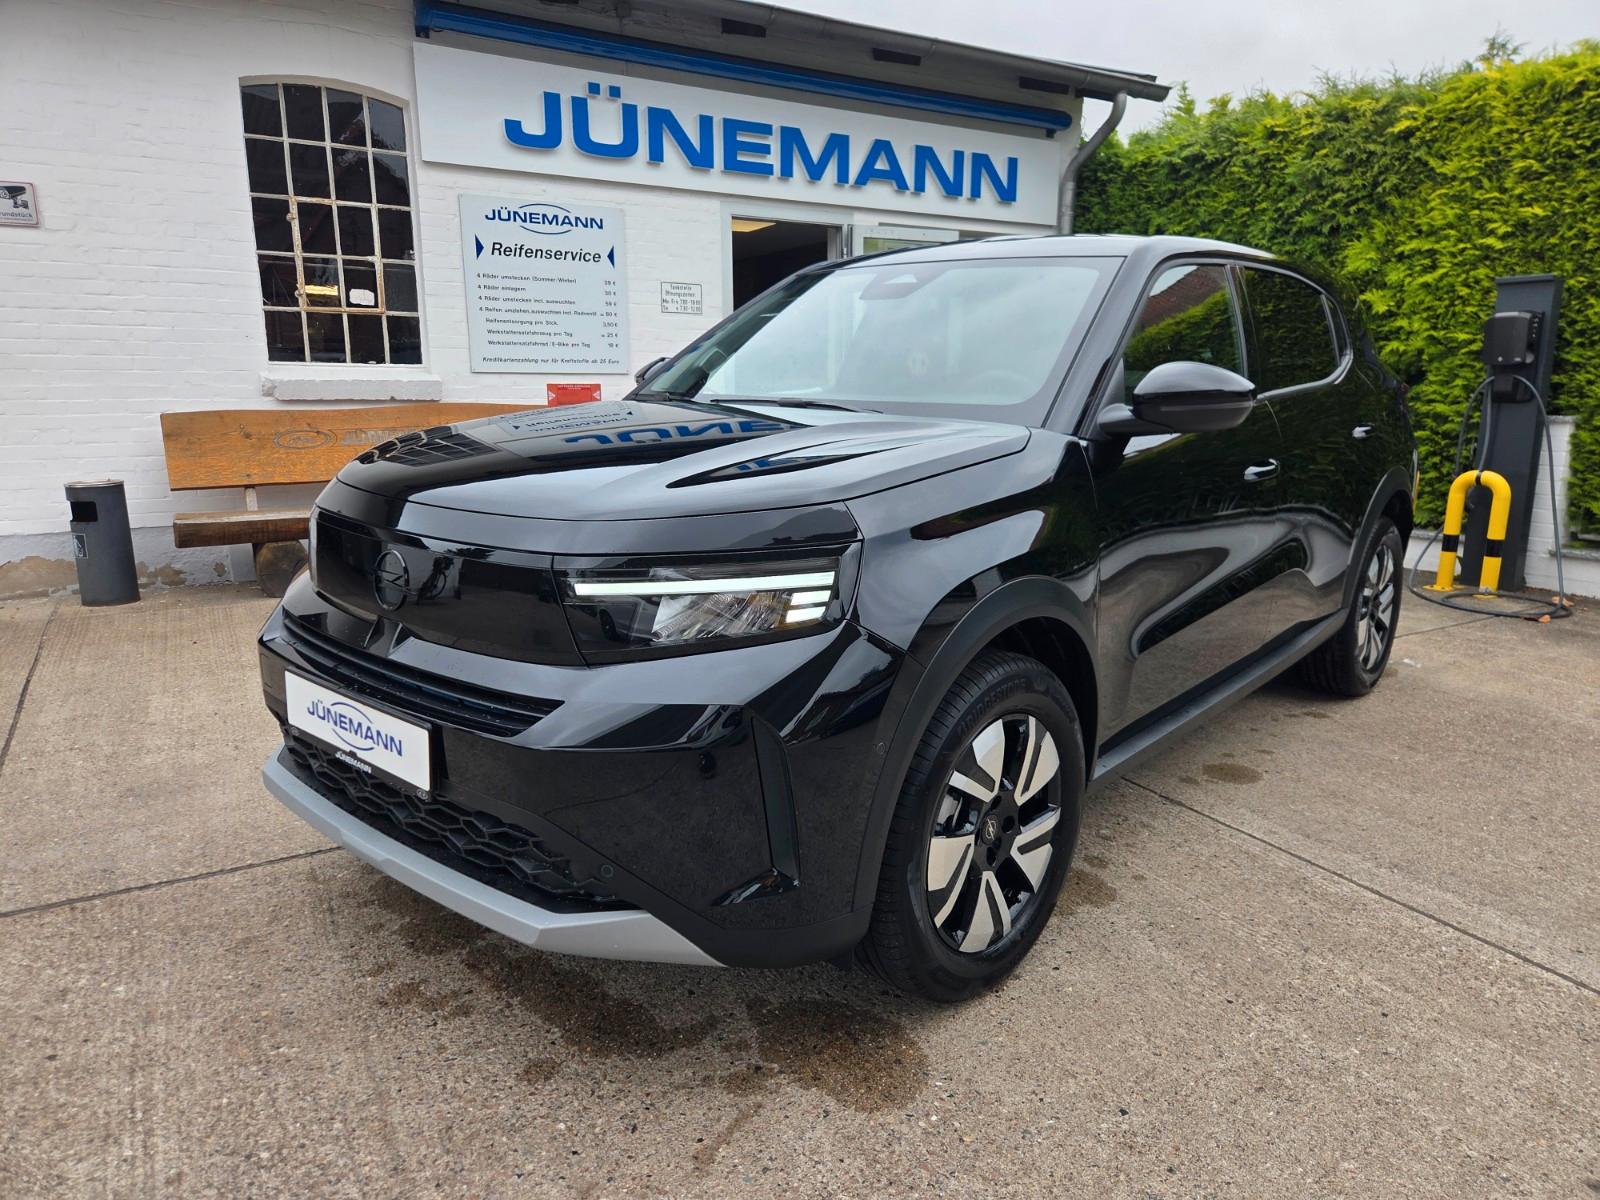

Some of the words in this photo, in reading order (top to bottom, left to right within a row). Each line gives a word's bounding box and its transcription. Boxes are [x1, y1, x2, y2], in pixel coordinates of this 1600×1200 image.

[503, 82, 1019, 203] JÜNEMANN
[484, 206, 604, 230] JÜNEMANN
[491, 242, 602, 263] Reifenservice
[306, 698, 403, 757] JÜNEMANN
